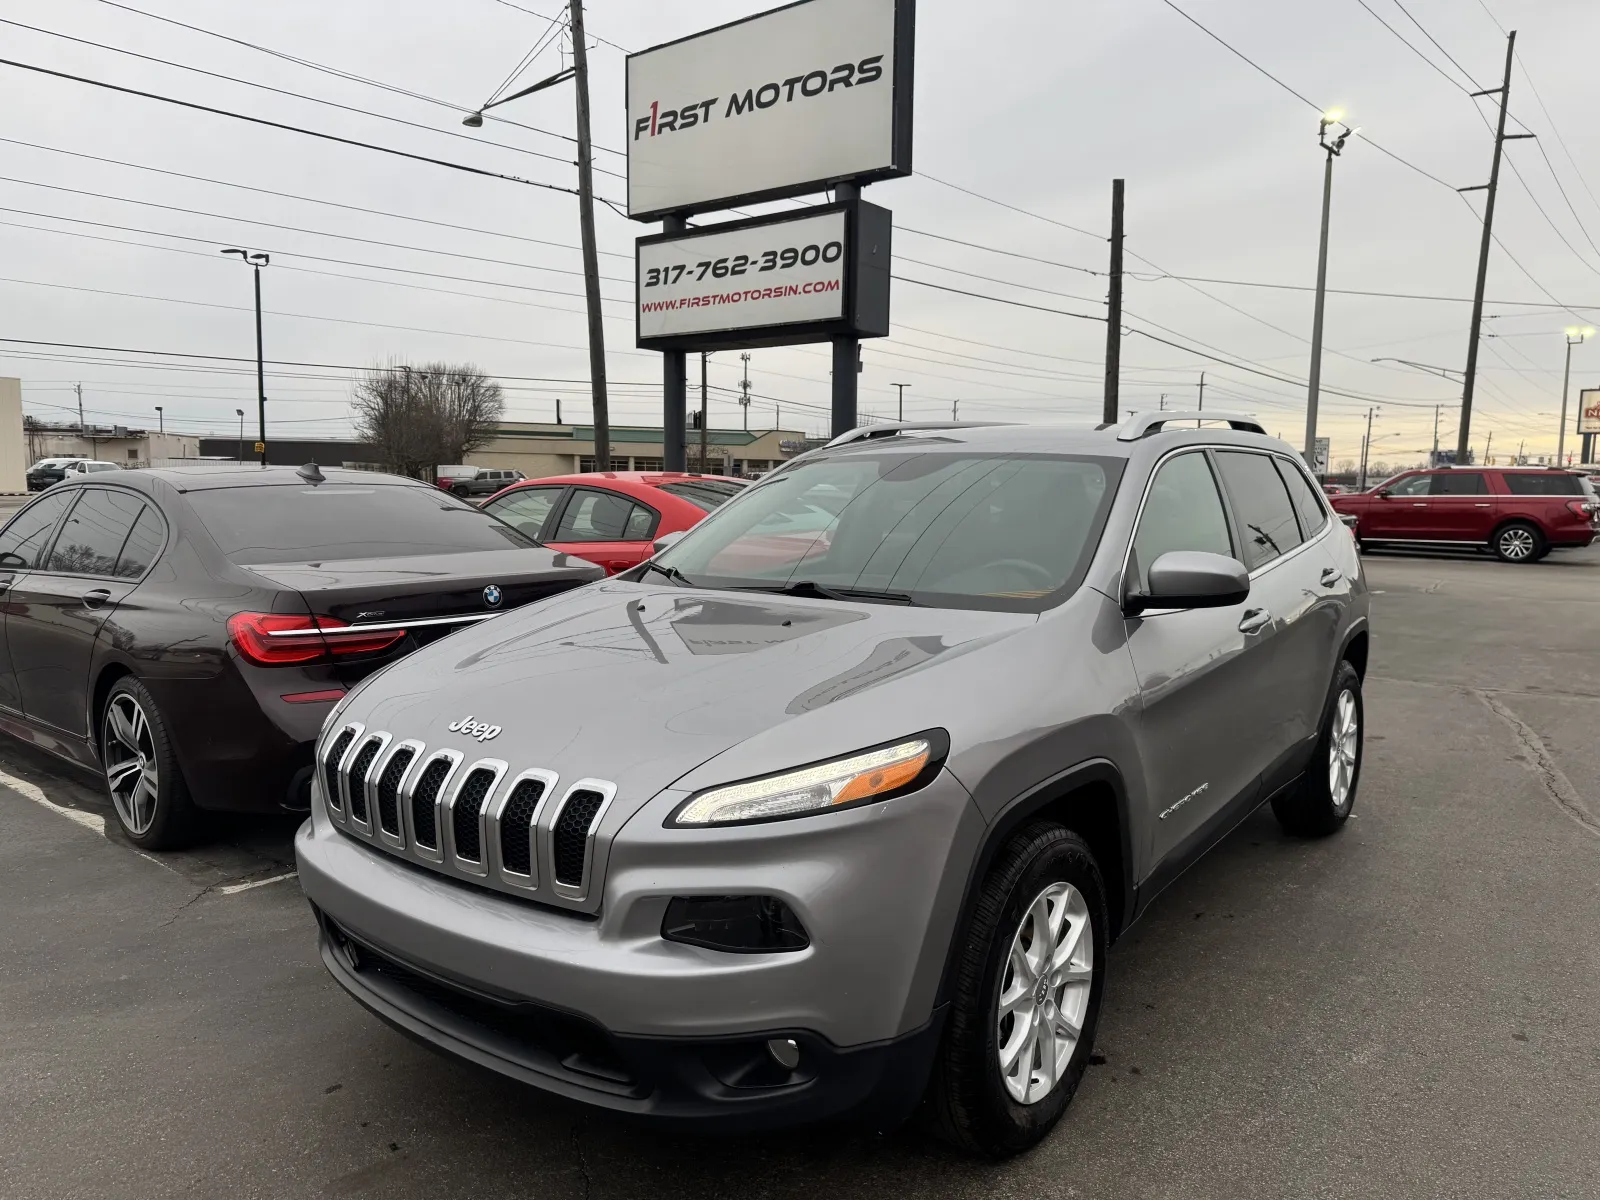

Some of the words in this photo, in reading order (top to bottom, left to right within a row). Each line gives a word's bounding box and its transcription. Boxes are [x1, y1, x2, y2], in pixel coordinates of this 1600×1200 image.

[725, 54, 885, 118] MOTORS
[645, 241, 843, 288] 317-762-3900
[641, 280, 841, 313] WWW.FIRSTMOTORSIN.COM
[448, 715, 503, 743] Jeep
